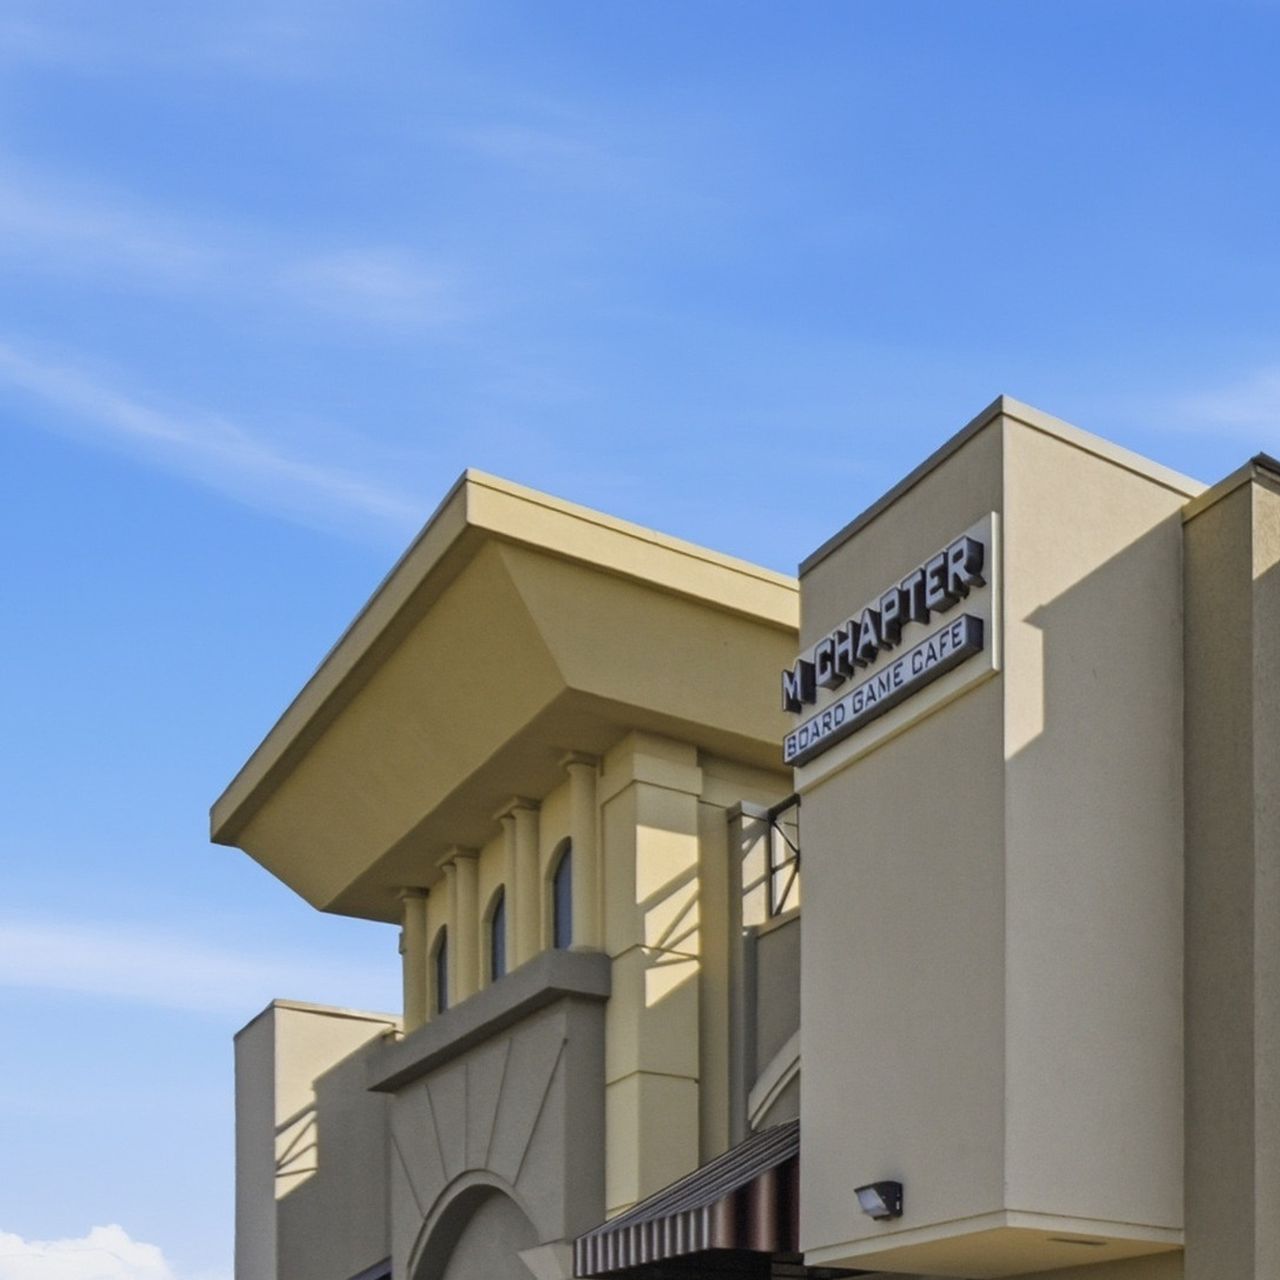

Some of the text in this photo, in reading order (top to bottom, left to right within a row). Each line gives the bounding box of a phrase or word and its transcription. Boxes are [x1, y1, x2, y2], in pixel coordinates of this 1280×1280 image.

[782, 535, 986, 713] M CHAPTER
[786, 621, 964, 758] BOARD GAME CAFE
